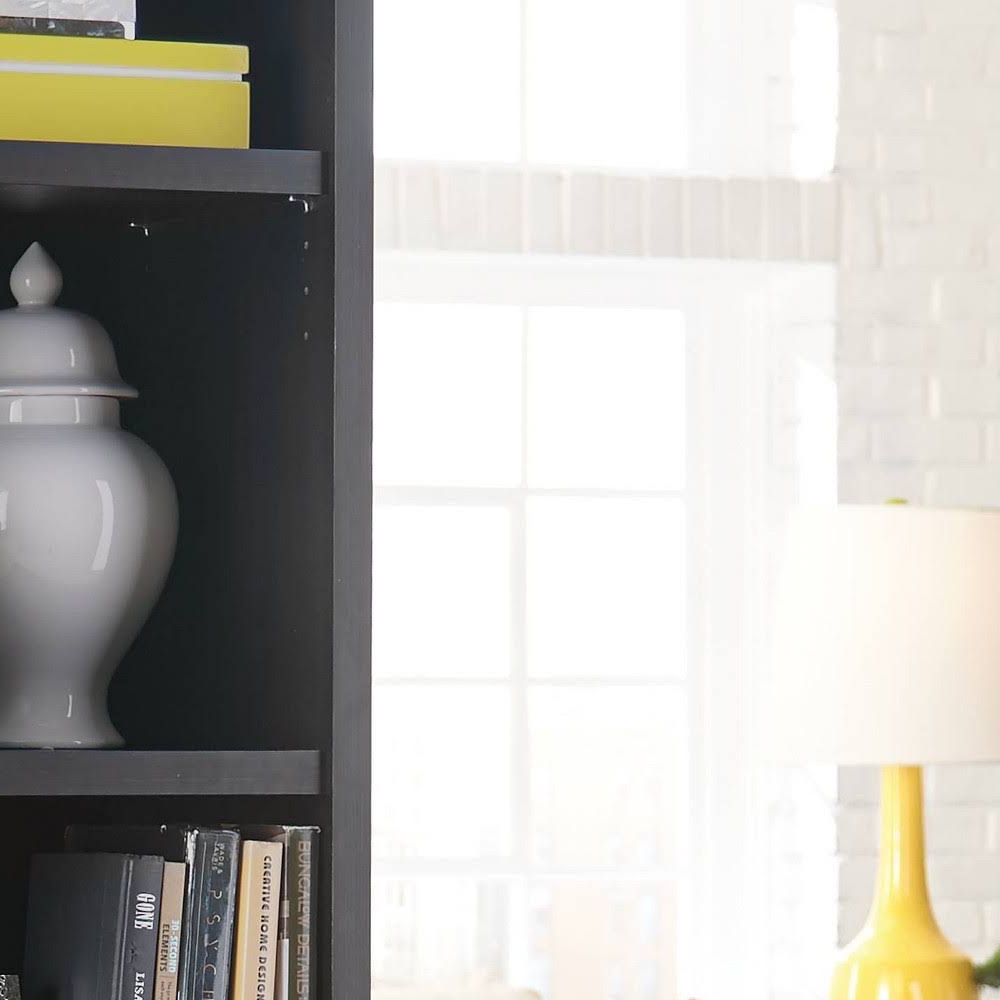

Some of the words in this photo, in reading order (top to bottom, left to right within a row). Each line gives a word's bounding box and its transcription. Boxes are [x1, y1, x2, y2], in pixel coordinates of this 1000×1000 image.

[262, 855, 273, 911] CREATIVE
[298, 839, 312, 927] BUNGALOW
[133, 893, 156, 930] GONE
[259, 914, 270, 952] HOME
[160, 923, 171, 973] ELEMENTS
